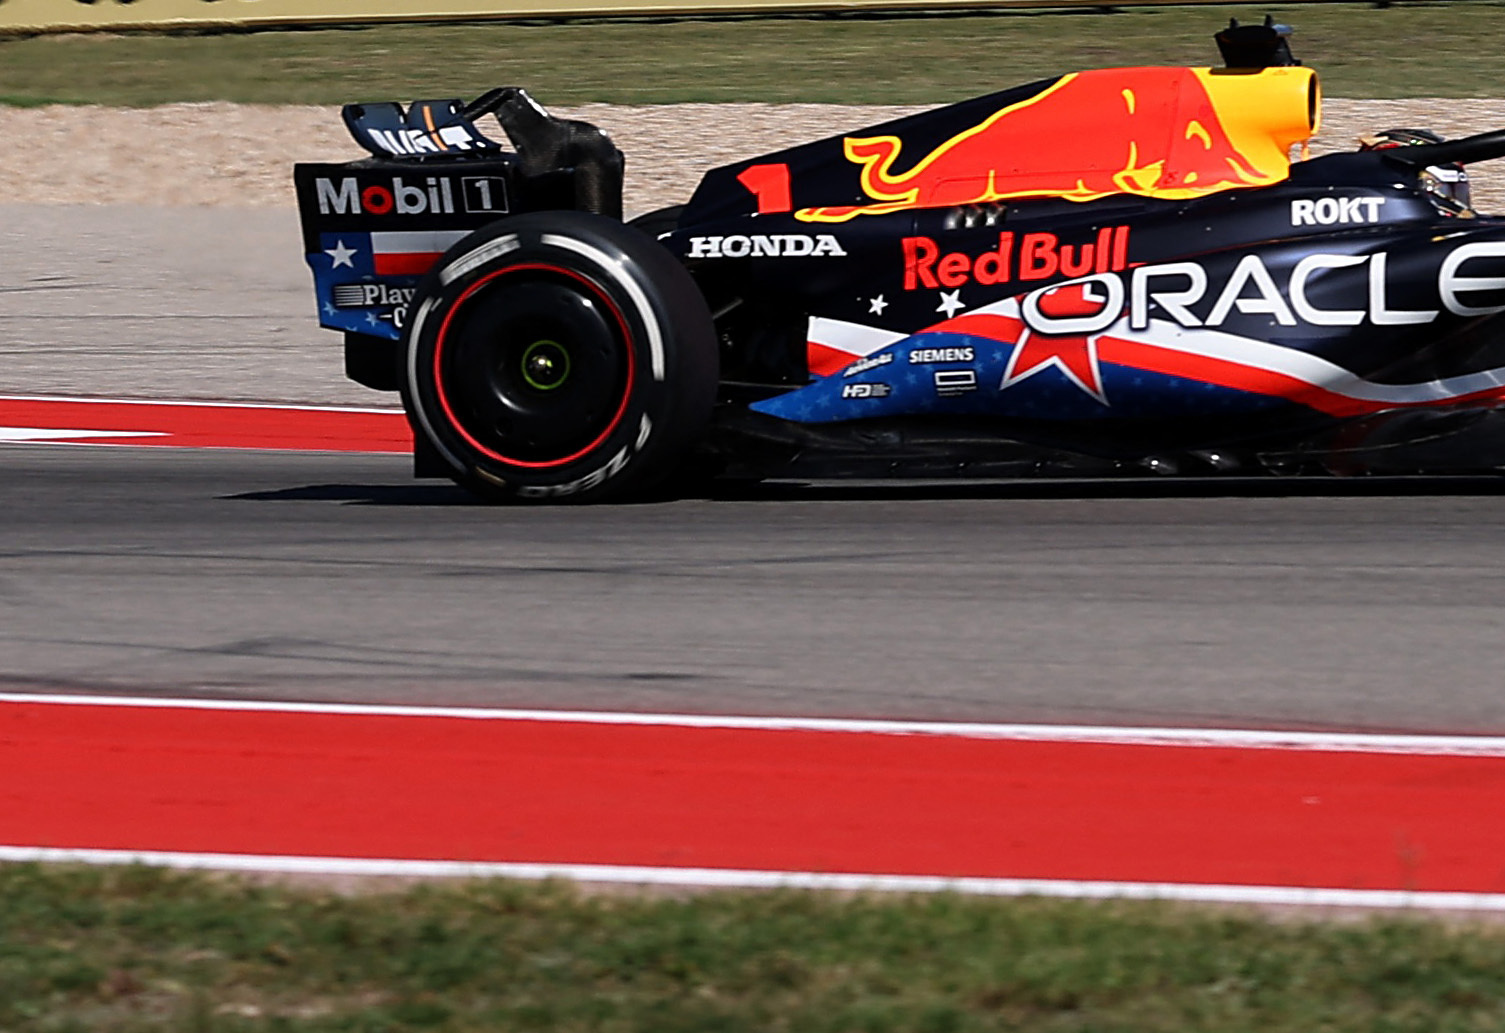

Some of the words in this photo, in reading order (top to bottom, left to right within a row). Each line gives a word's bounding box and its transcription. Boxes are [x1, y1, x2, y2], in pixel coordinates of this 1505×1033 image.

[315, 177, 453, 214] Mobil
[474, 180, 493, 210] 1
[737, 164, 793, 214] 1
[1291, 197, 1385, 226] ROKT
[685, 235, 847, 258] HONDA
[902, 232, 1013, 291] Red
[1020, 225, 1130, 281] Bull
[909, 347, 975, 364] SIEMENS
